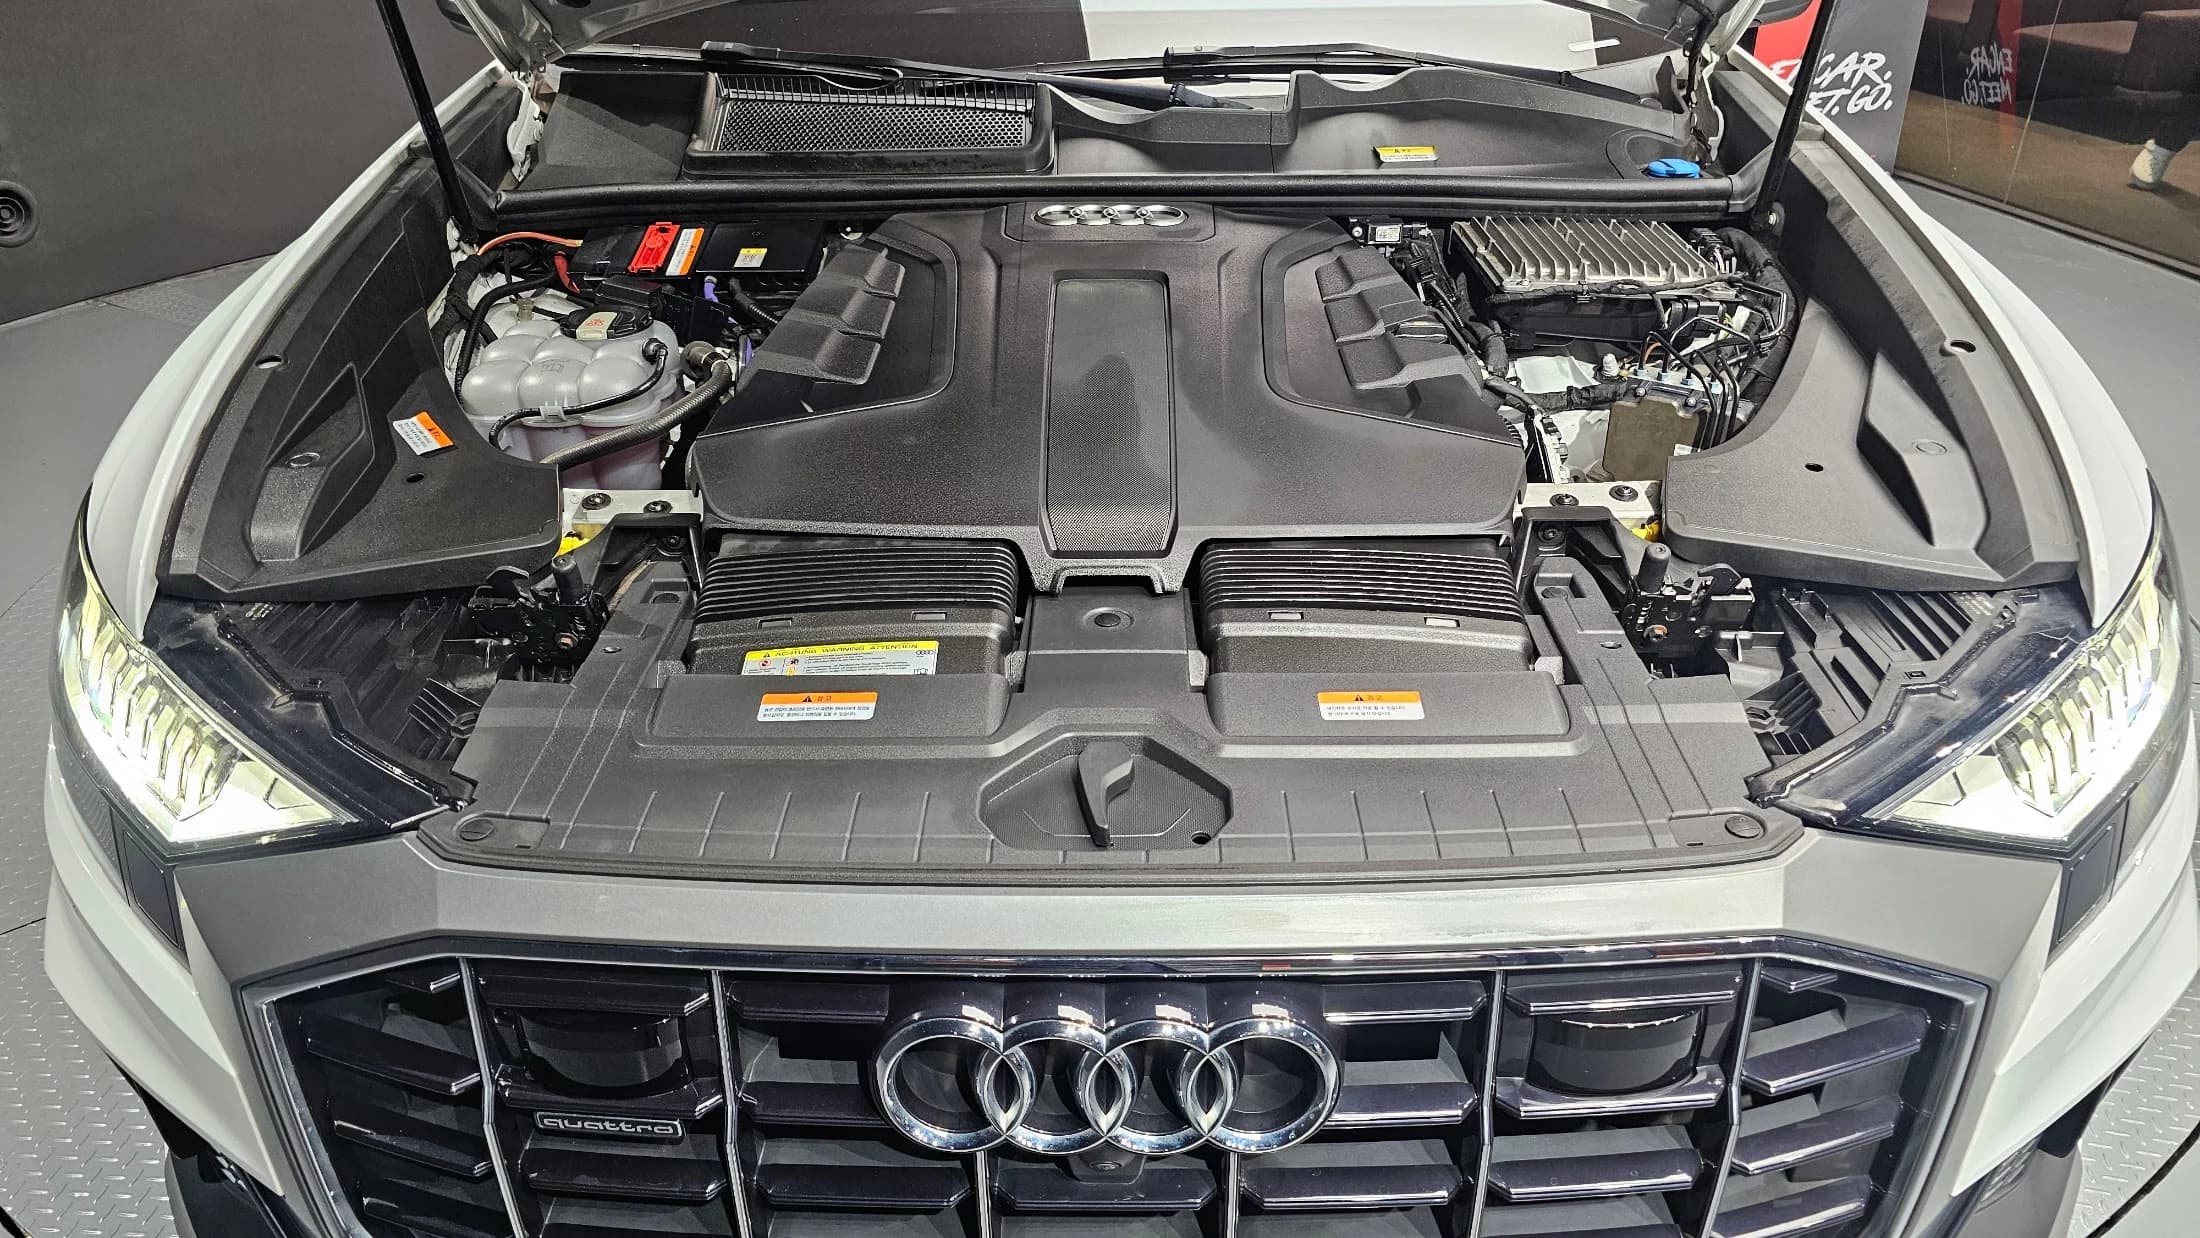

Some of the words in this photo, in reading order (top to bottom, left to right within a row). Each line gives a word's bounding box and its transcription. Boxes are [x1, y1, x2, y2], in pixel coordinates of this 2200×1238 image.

[1846, 82, 1893, 114] GO.
[822, 645, 865, 653] WARNING
[870, 643, 918, 651] ATTENTION
[543, 1118, 674, 1134] quattro
